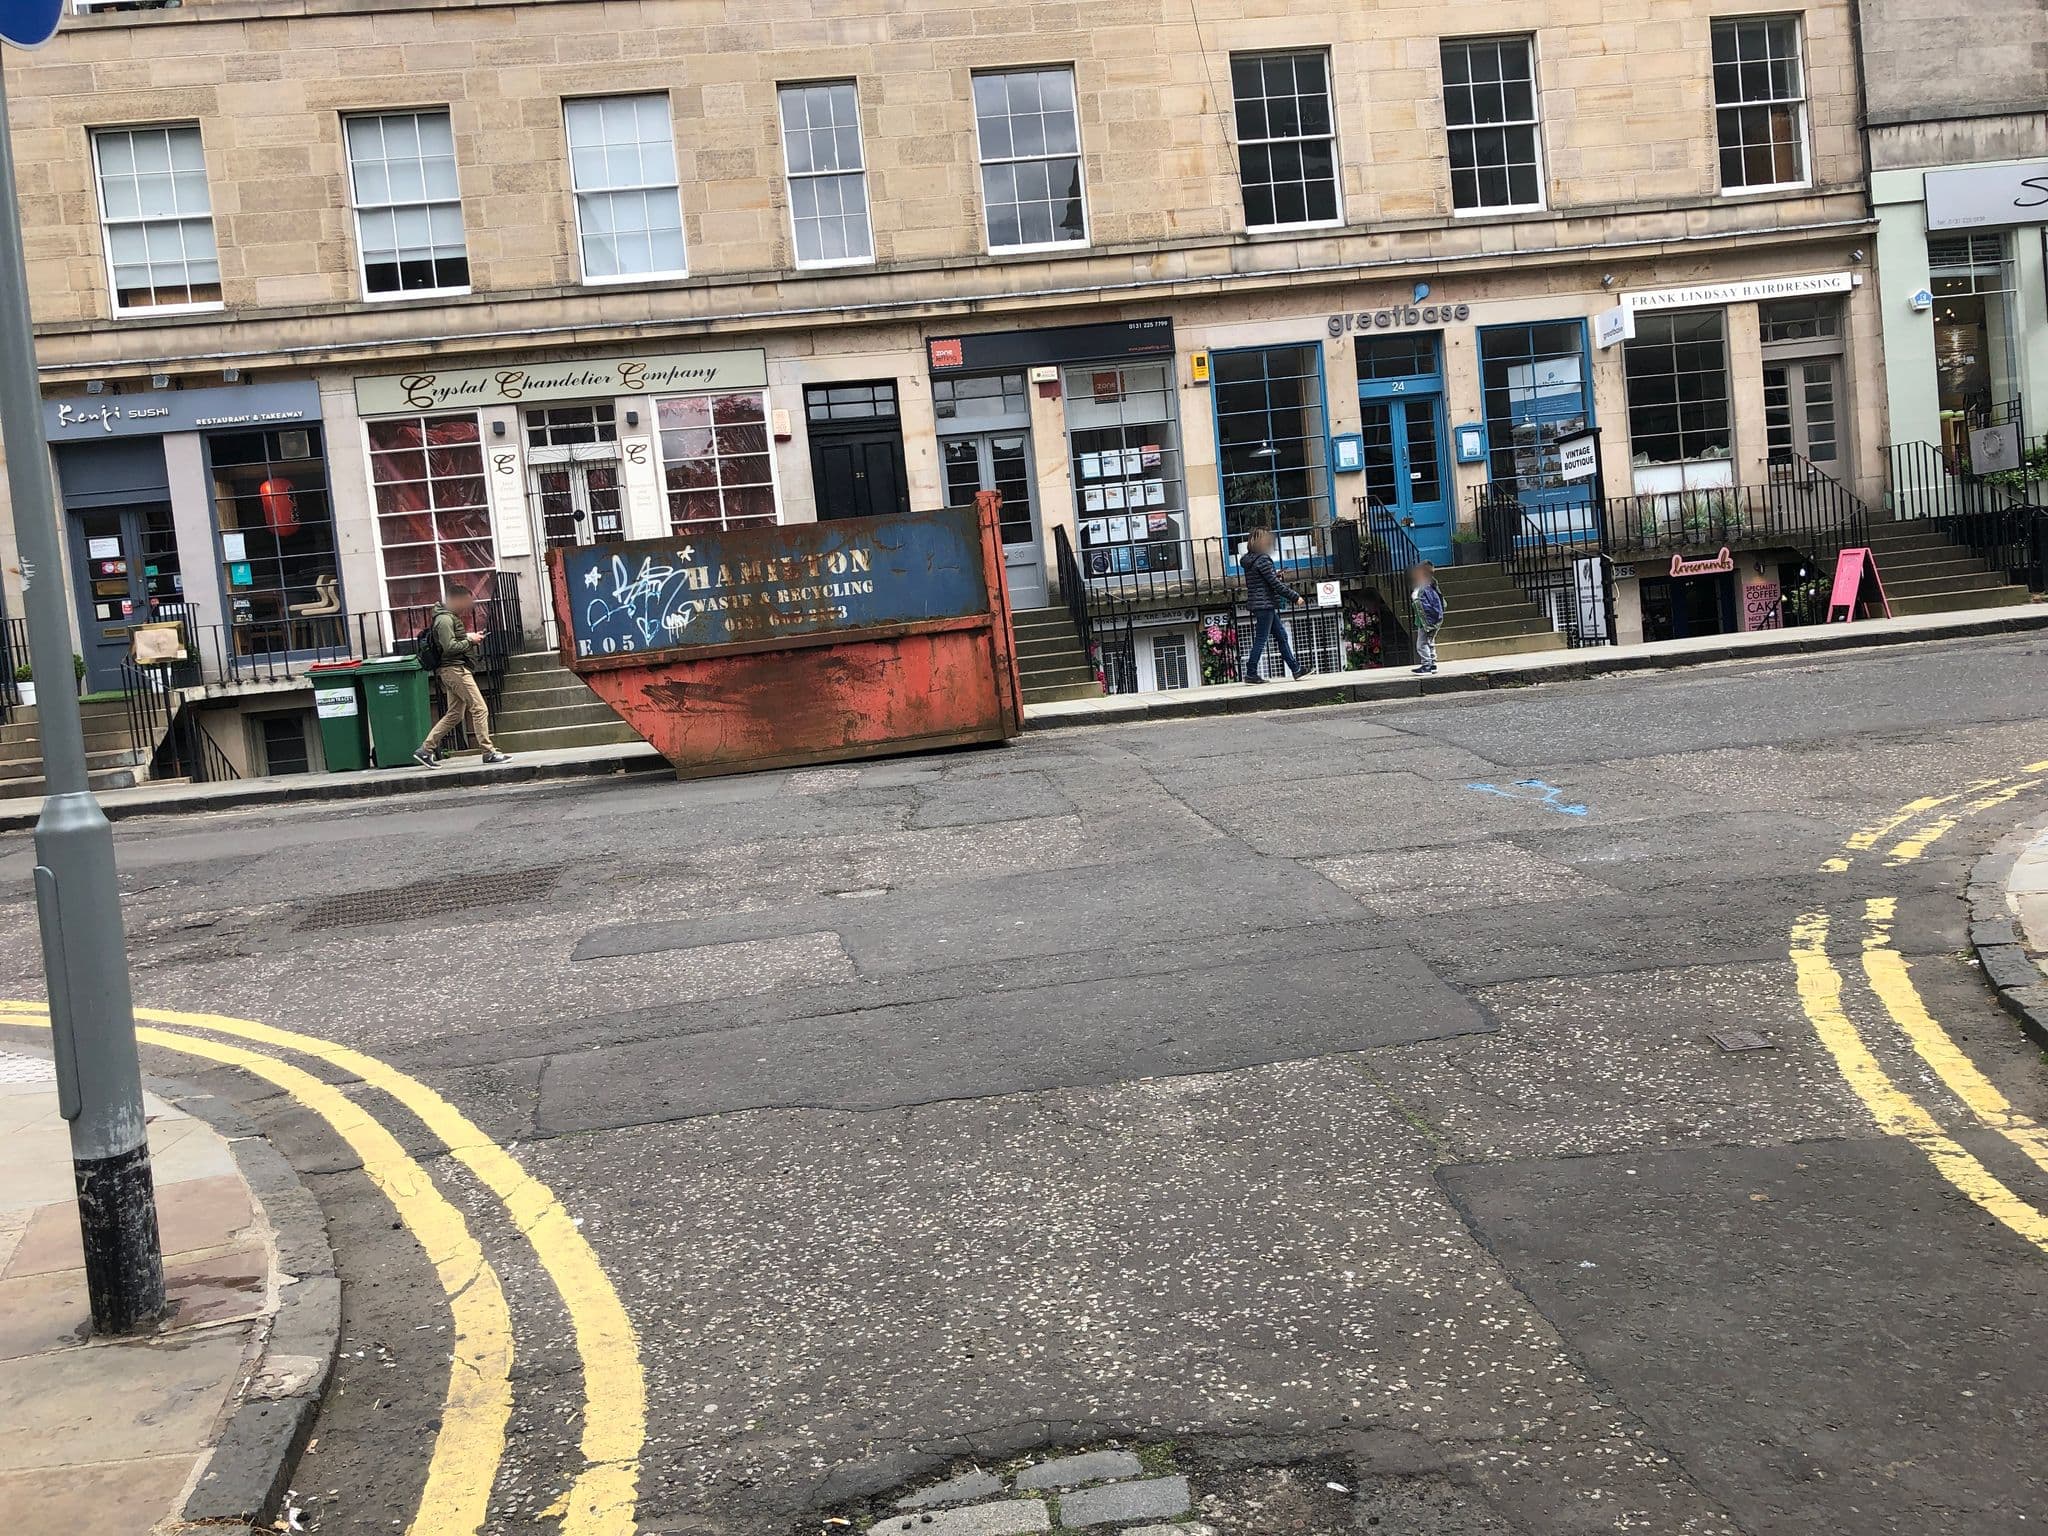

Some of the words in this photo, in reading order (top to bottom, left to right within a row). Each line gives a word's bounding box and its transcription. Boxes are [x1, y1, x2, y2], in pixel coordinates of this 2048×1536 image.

[1632, 295, 1676, 306] FRANK
[1681, 288, 1739, 302] LINDSAY
[1743, 278, 1841, 297] HAIRDRESSING
[1128, 322, 1142, 330] 0131
[1327, 303, 1470, 337] greatbase
[400, 374, 488, 409] Crystal
[494, 370, 613, 400] Chandelier
[617, 361, 720, 391] Company
[1391, 380, 1406, 392] 24
[58, 402, 121, 432] Kenji
[128, 406, 169, 419] SUSHI
[196, 414, 251, 426] RESTAURANT
[252, 414, 259, 422] &
[261, 410, 304, 420] TAKEAWAY
[1565, 445, 1591, 459] VINTAGE
[1564, 455, 1594, 471] BOUTIQUE
[687, 548, 872, 591] HAMILTON
[776, 580, 873, 604] RECYCLING
[1746, 584, 1777, 592] SPECIALITY
[1746, 590, 1778, 600] COFFEE
